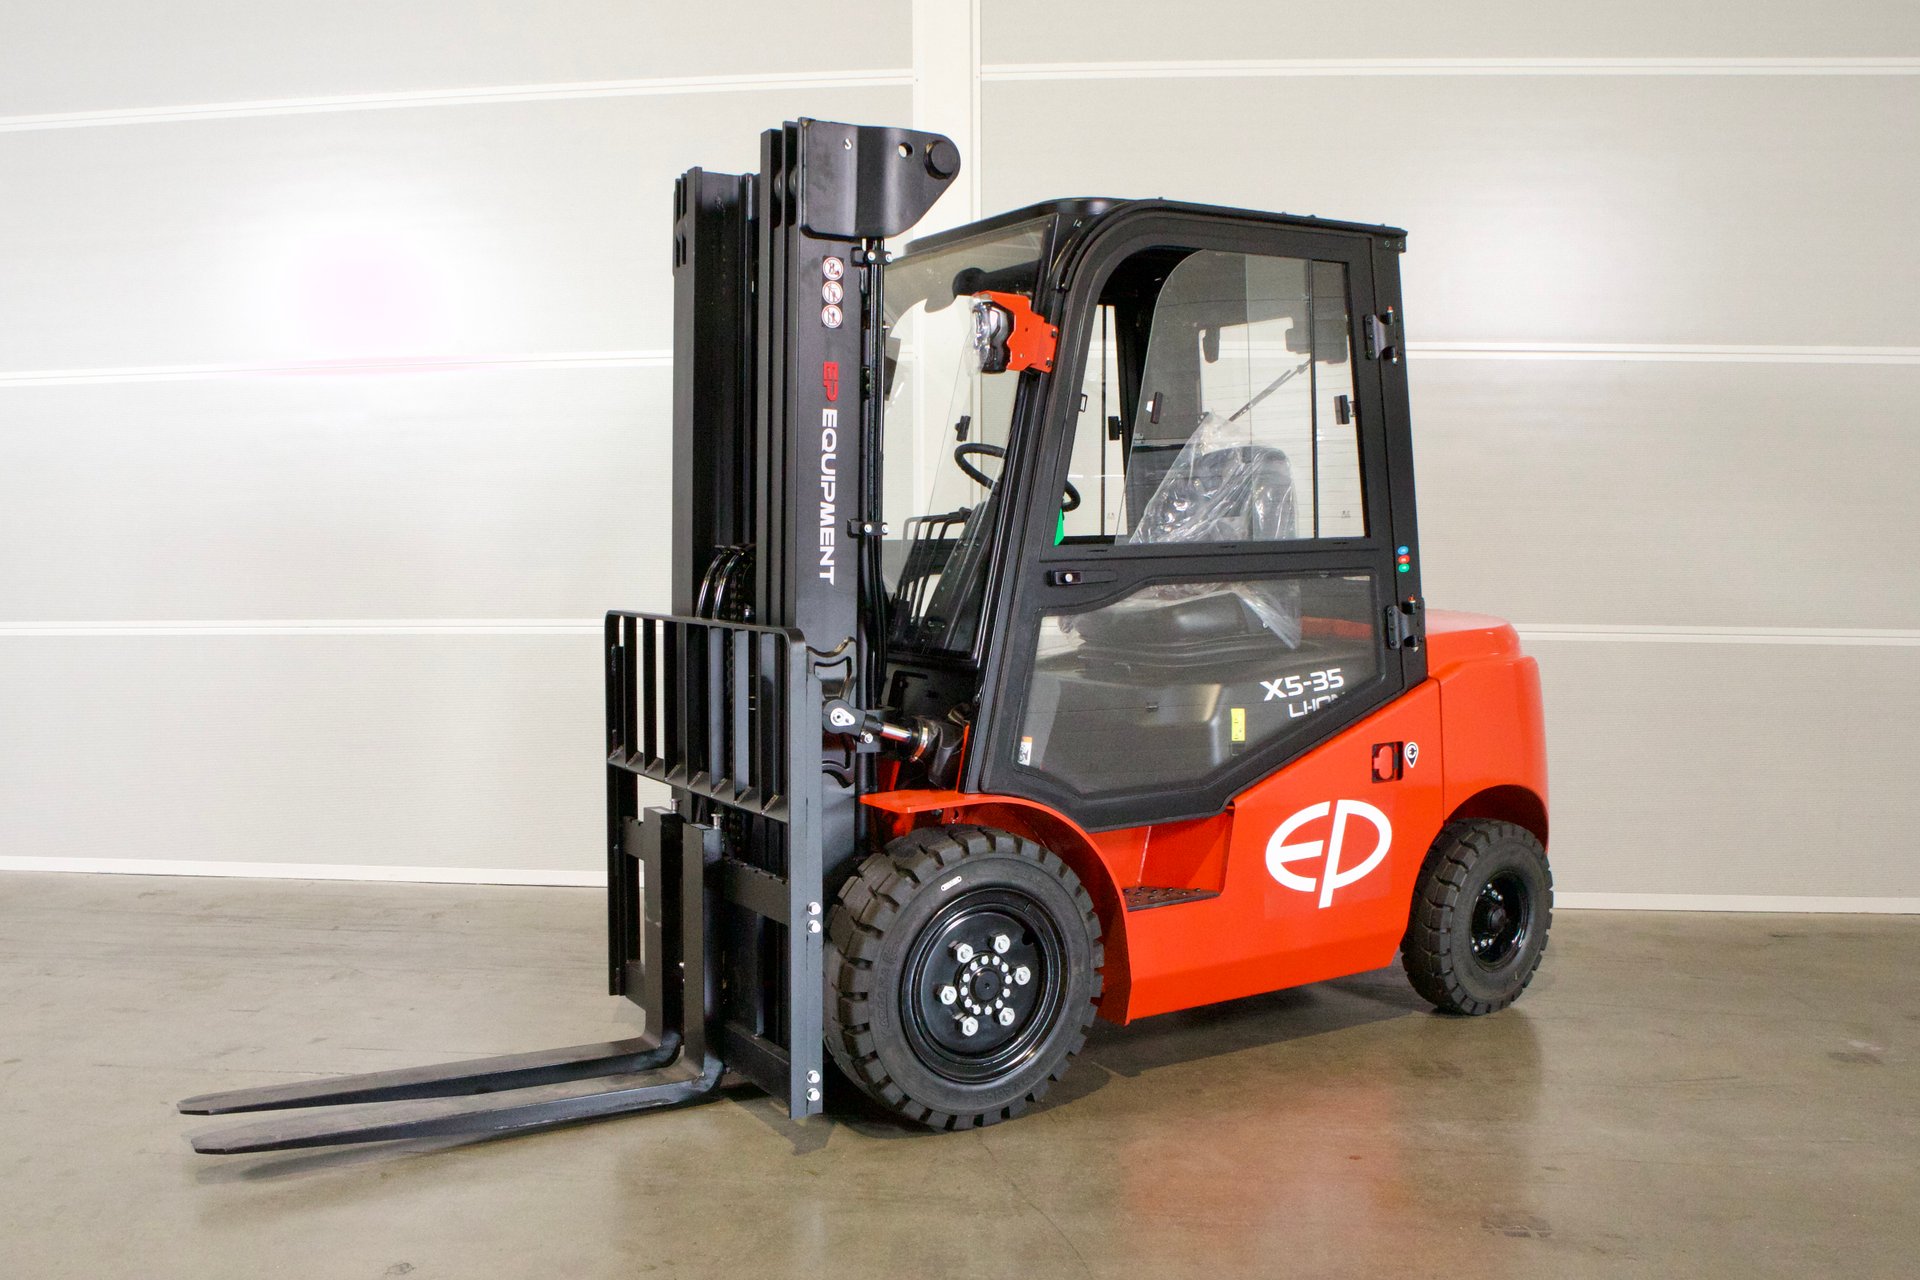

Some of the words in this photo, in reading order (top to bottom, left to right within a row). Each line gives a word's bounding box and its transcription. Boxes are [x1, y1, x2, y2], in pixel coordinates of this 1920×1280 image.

[823, 361, 839, 401] EP
[819, 408, 838, 585] EQUIPMENT
[1259, 668, 1344, 701] X5-35
[1265, 799, 1393, 909] EP
